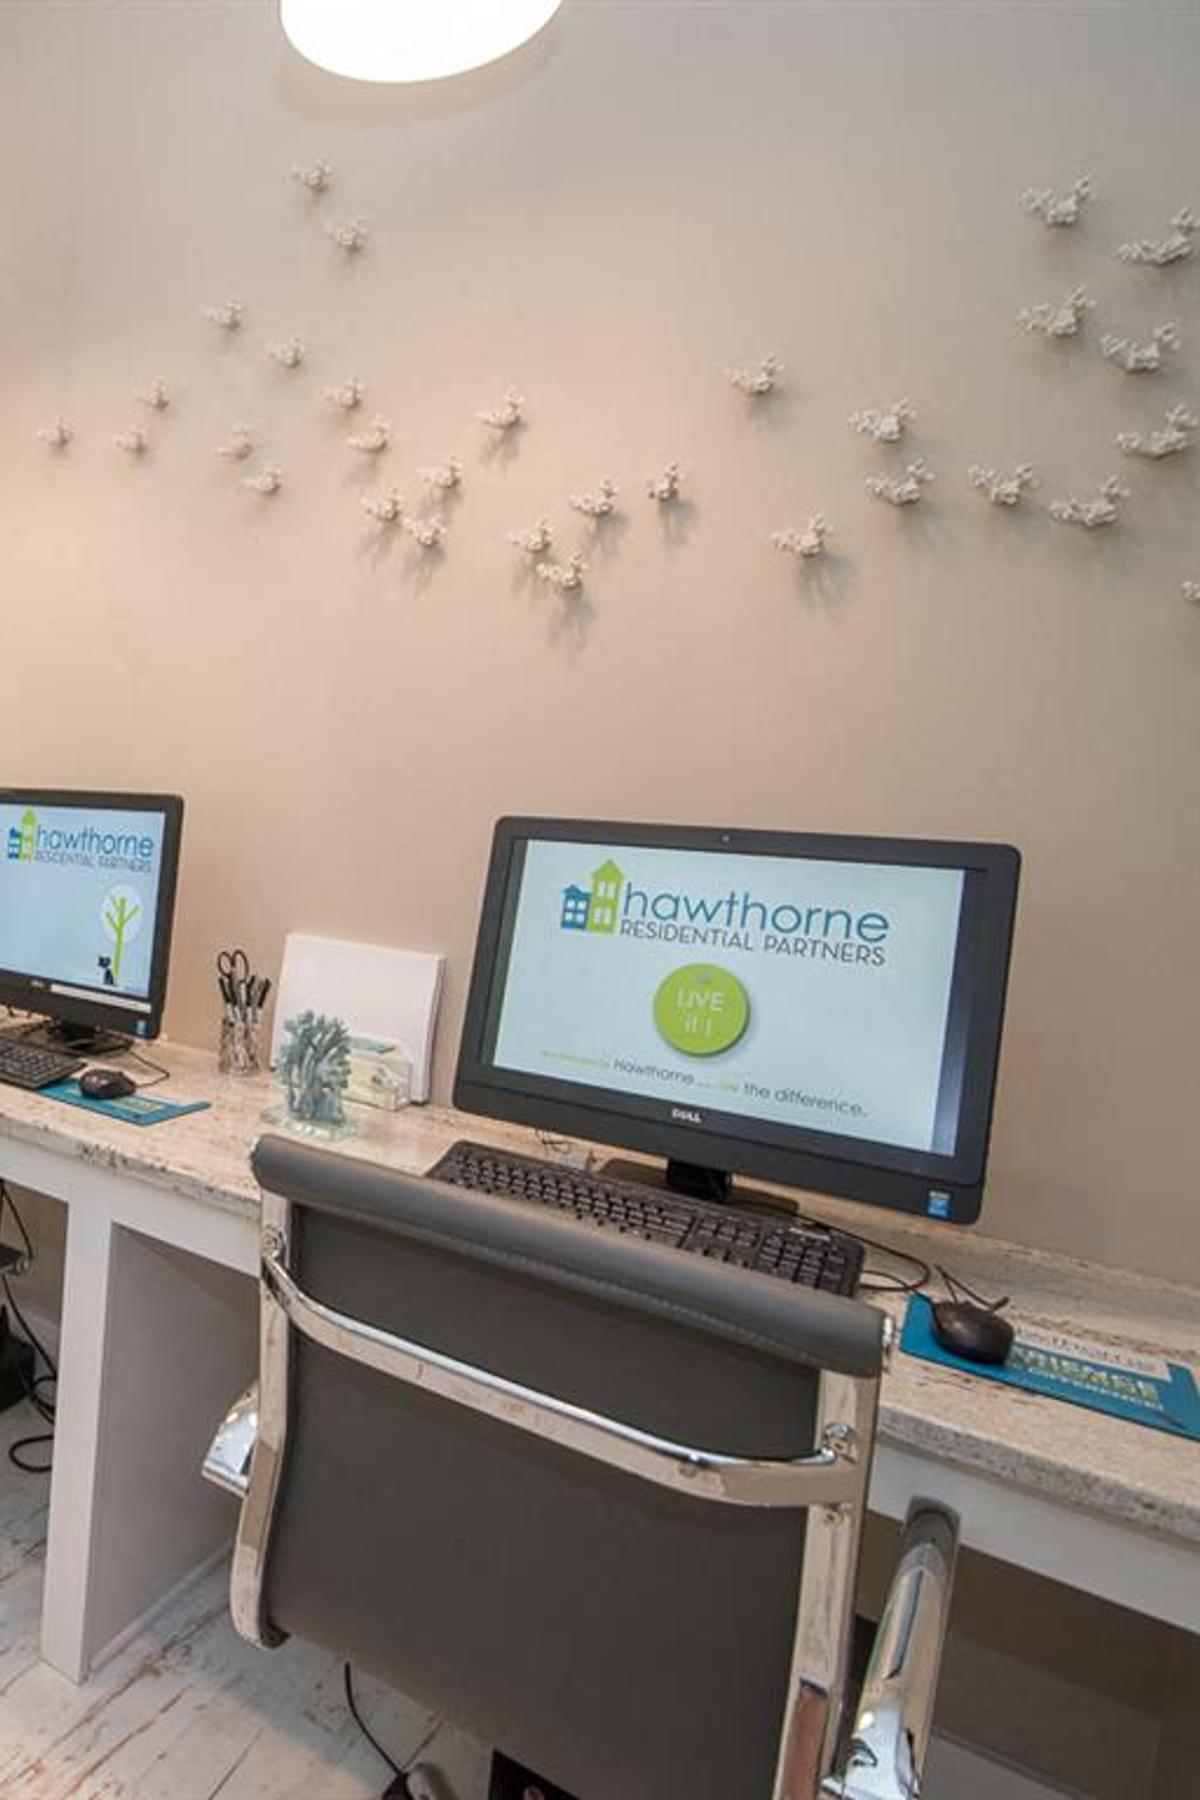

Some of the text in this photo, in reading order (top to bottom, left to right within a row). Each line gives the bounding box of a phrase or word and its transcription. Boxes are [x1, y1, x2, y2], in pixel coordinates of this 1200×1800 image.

[37, 824, 154, 858] hawthorne
[623, 881, 889, 944] hawthorne
[620, 918, 886, 967] RESIDENTIAL PARTNERS
[677, 987, 725, 1013] LIVE
[613, 1057, 695, 1086] Hawthorne
[743, 1080, 771, 1102] the
[774, 1085, 868, 1119] difference.
